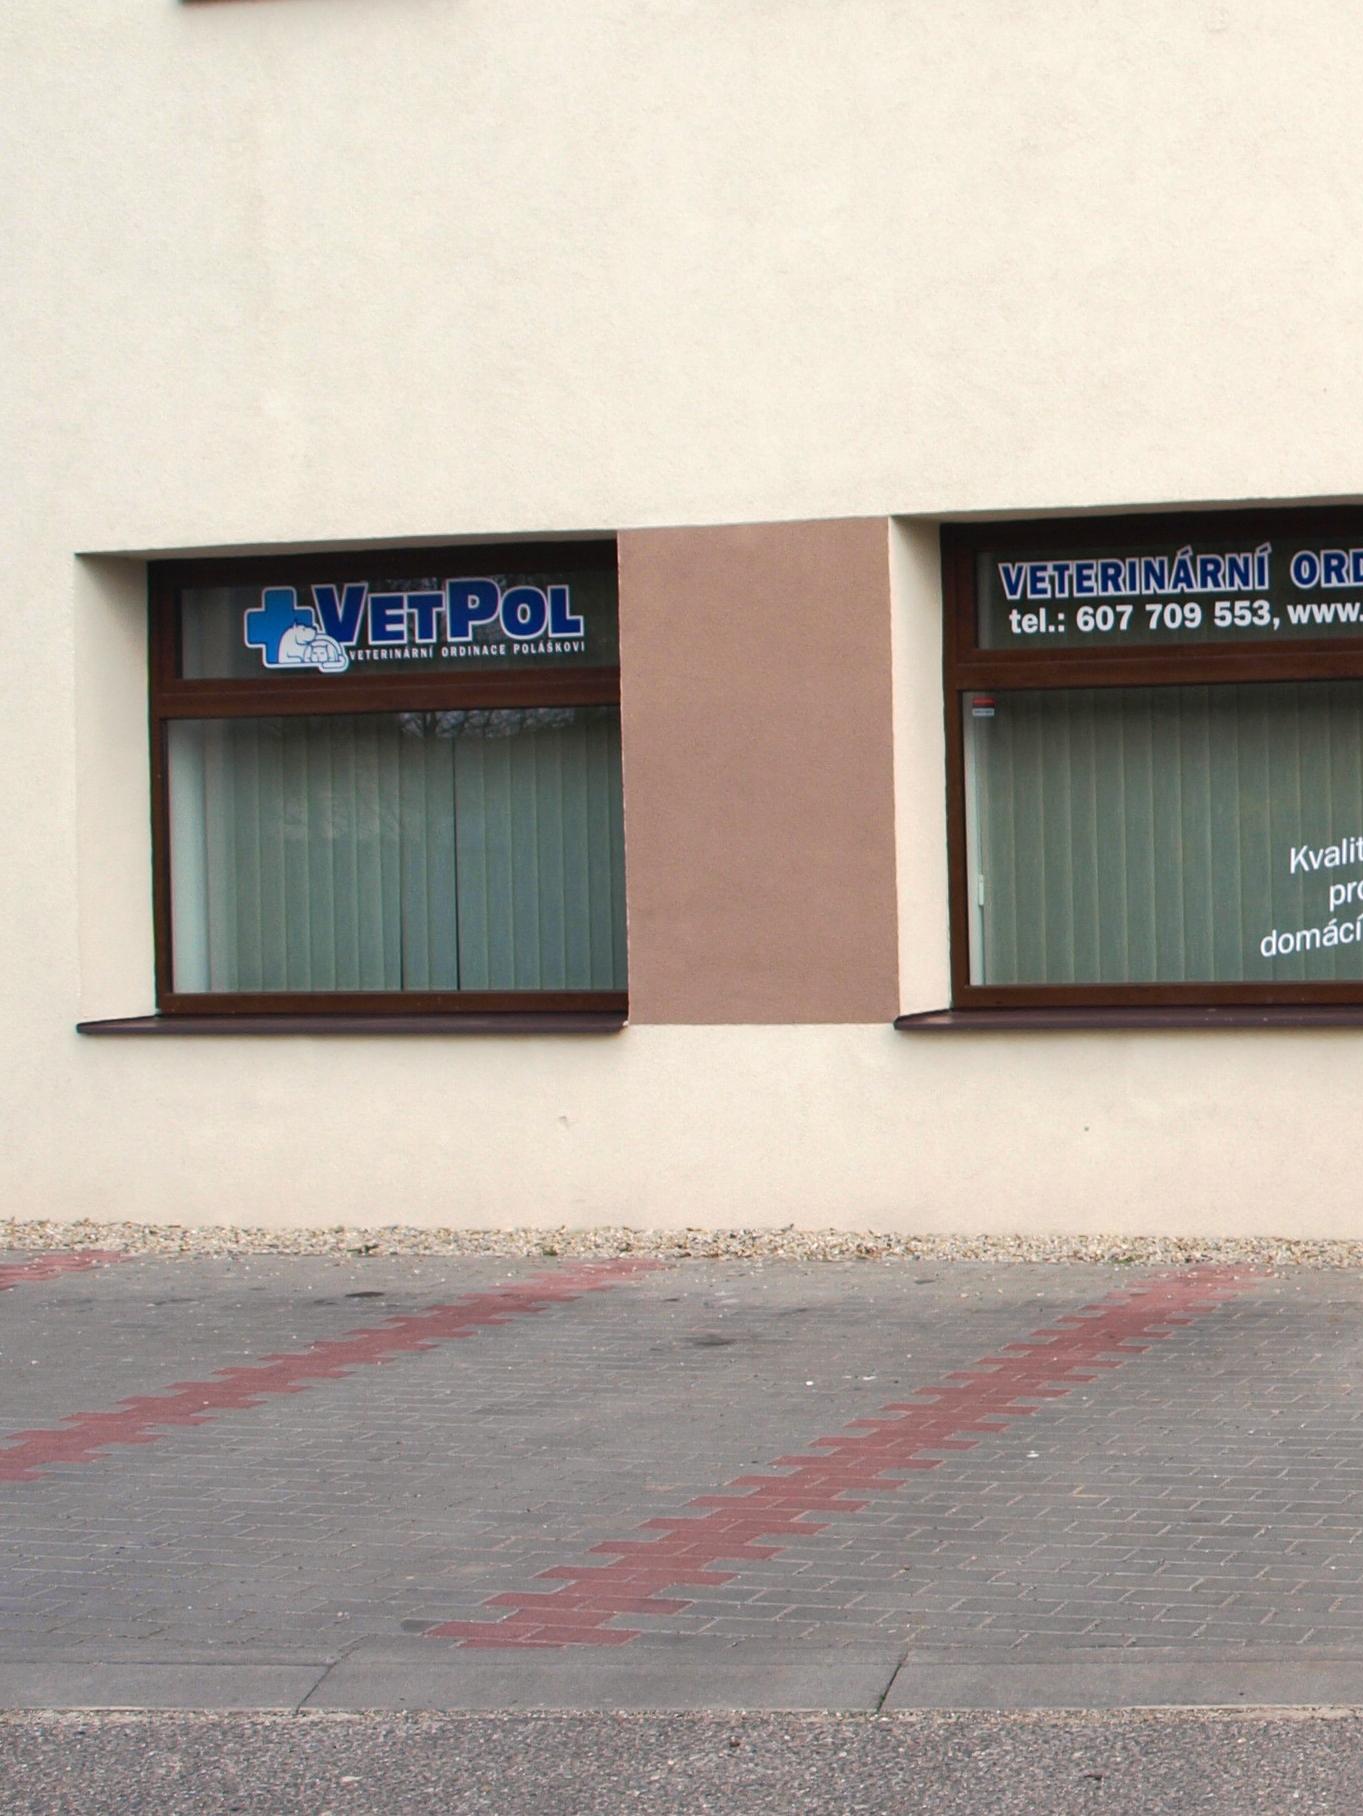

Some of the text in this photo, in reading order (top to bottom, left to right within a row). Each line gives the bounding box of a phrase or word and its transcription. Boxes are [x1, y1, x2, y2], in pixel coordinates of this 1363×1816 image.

[997, 544, 1272, 600] VETERINÁRNÍ
[1009, 608, 1065, 634] tel.:
[1076, 605, 1133, 631] 607
[1146, 603, 1202, 630] 709
[1213, 601, 1281, 630] 553,
[349, 640, 585, 662] VETERINÁRNÍ ORDINACE POLÁŠKOVI
